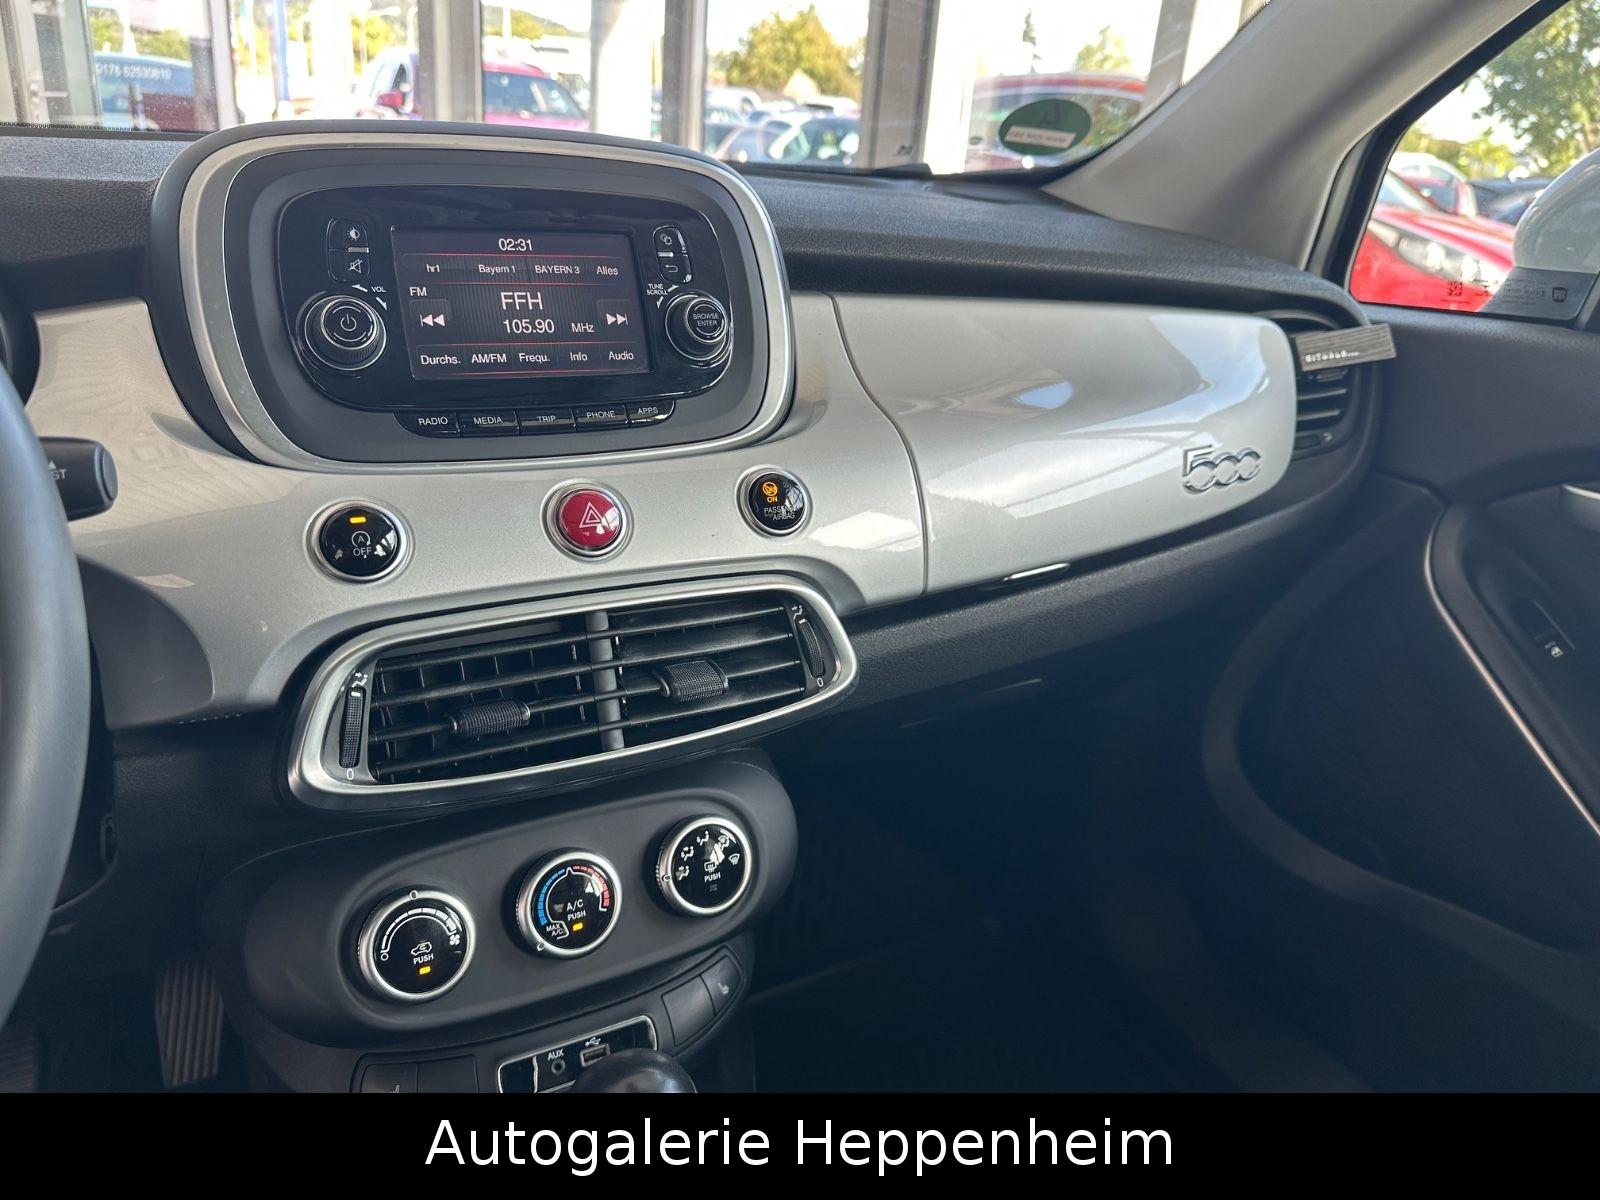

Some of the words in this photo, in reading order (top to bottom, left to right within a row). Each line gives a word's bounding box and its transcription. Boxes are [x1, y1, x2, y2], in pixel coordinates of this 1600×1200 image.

[498, 238, 533, 251] 02:31
[426, 263, 440, 273] hr1
[478, 264, 510, 274] Bayern
[511, 265, 516, 273] 1
[535, 265, 573, 274] BAYERN
[574, 265, 580, 274] 3
[596, 266, 619, 275] Alles
[409, 287, 427, 297] FM
[501, 292, 544, 310] FFH
[693, 312, 719, 320] BROWSE
[503, 319, 555, 334] 105.90
[571, 323, 595, 334] MHz
[421, 354, 461, 365] Durchs.
[471, 354, 507, 364] AM/FM
[519, 353, 551, 364] Frequ.
[570, 352, 588, 362] Info
[608, 351, 634, 361] Audio
[586, 410, 616, 419] PHONE
[637, 406, 659, 415] APPS
[418, 417, 448, 425] RADIO
[473, 416, 503, 425] MEDIA
[537, 415, 556, 424] TRIP
[1182, 444, 1261, 494] 500
[353, 547, 372, 557] OFF
[704, 872, 721, 882] PUSH
[566, 899, 584, 911] A/C
[567, 910, 586, 921] PUSH
[546, 924, 560, 932] MAX
[551, 928, 564, 937] A/C
[413, 953, 434, 964] PUSH
[548, 1048, 564, 1060] AUX
